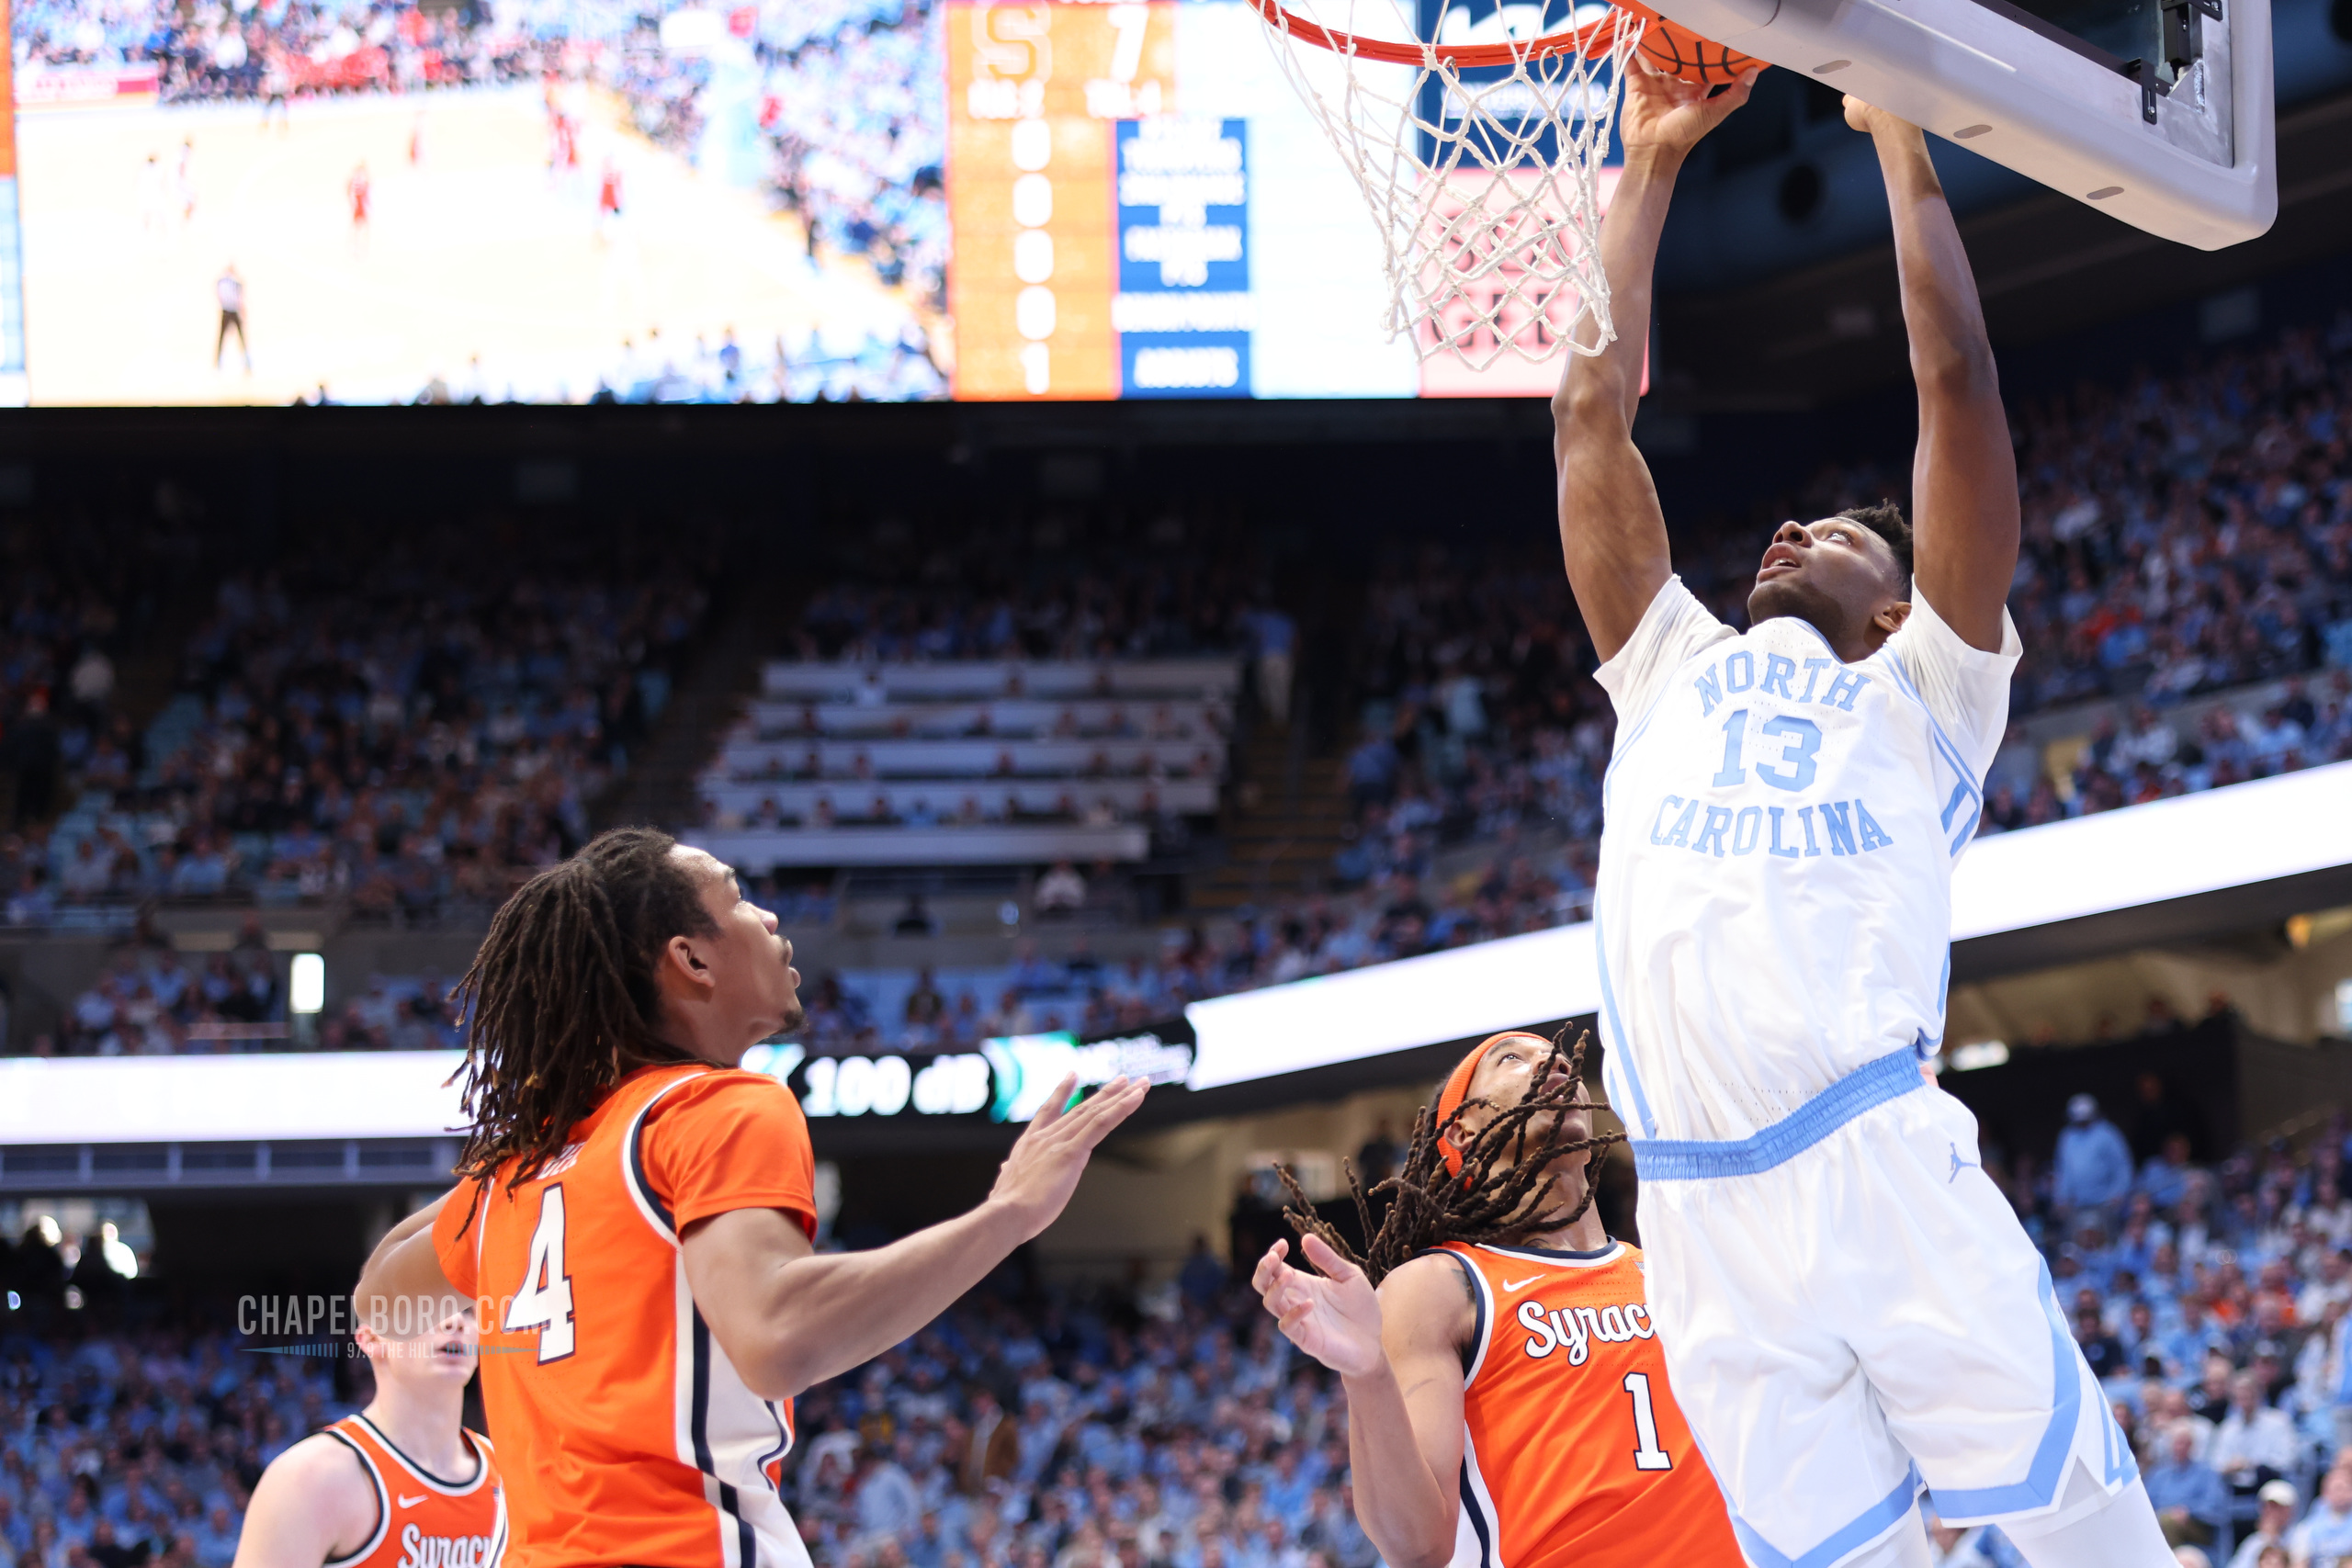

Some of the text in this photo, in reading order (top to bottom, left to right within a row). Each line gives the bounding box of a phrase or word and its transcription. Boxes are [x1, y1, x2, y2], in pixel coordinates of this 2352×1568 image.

[1694, 650, 1871, 717] NORTH
[1713, 708, 1822, 792] 13
[1650, 795, 1894, 858] CAROLINA
[801, 1055, 911, 1117] 100
[502, 1181, 575, 1366] 4
[1517, 1301, 1654, 1366] Syrac
[1623, 1371, 1673, 1471] 1
